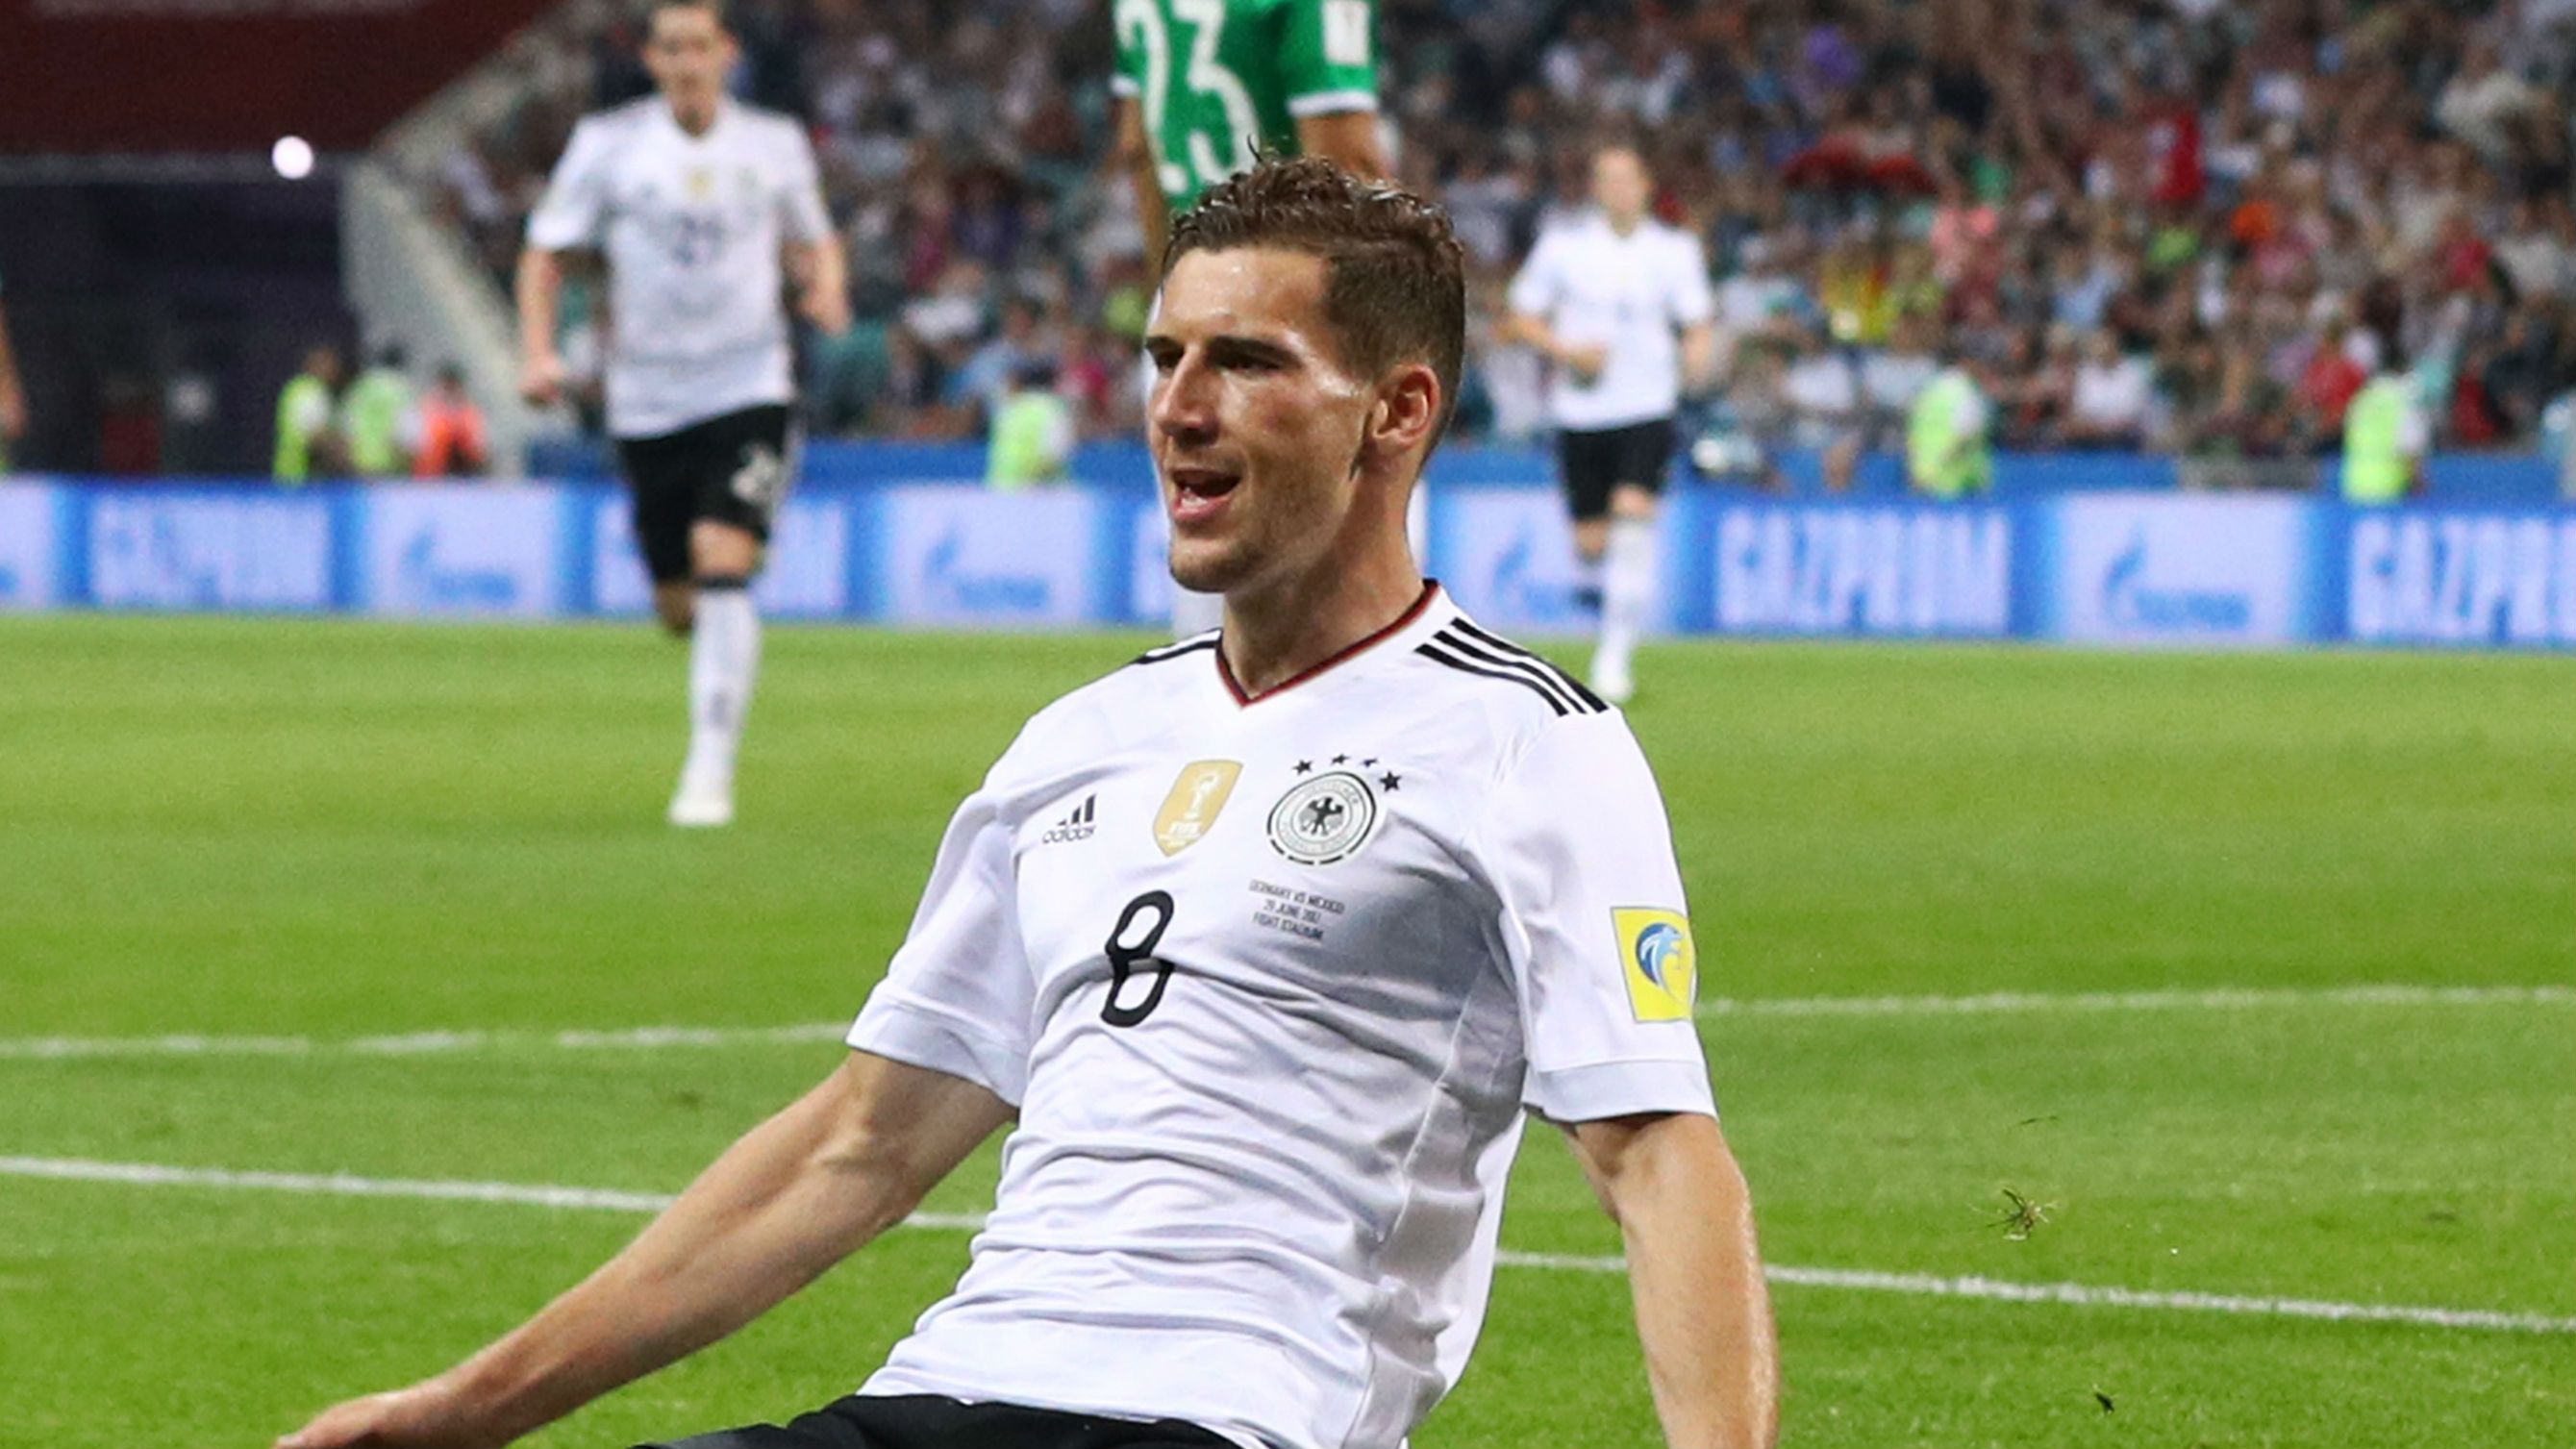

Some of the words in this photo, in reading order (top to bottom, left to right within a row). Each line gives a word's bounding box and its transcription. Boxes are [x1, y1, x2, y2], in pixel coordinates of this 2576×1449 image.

[1114, 0, 1262, 192] 23
[1717, 507, 2011, 630] GAZPROM
[1042, 824, 1096, 844] adidas
[1276, 902, 1301, 918] JUNE
[1309, 895, 1345, 914] MEXICO
[1281, 917, 1325, 941] STADIUM
[1100, 889, 1175, 1028] 8
